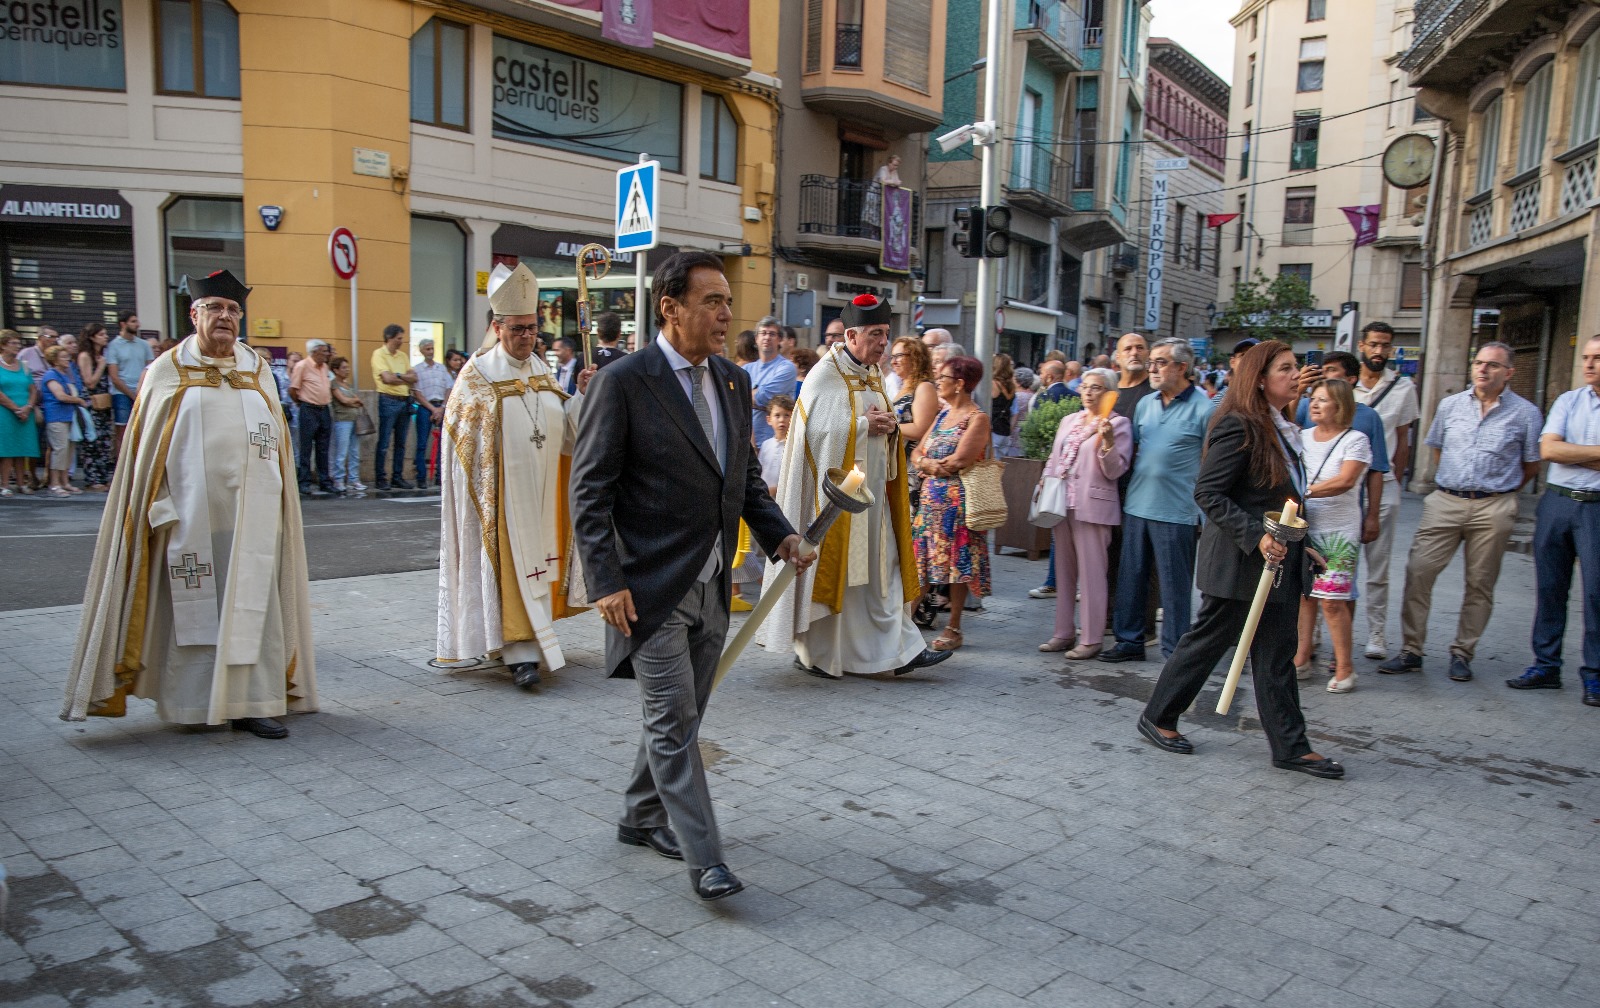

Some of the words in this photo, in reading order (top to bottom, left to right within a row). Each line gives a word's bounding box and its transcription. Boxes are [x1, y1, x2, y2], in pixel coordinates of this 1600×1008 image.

[493, 55, 599, 106] castells
[493, 84, 599, 123] perruquers
[1147, 180, 1166, 323] METROPOLIS
